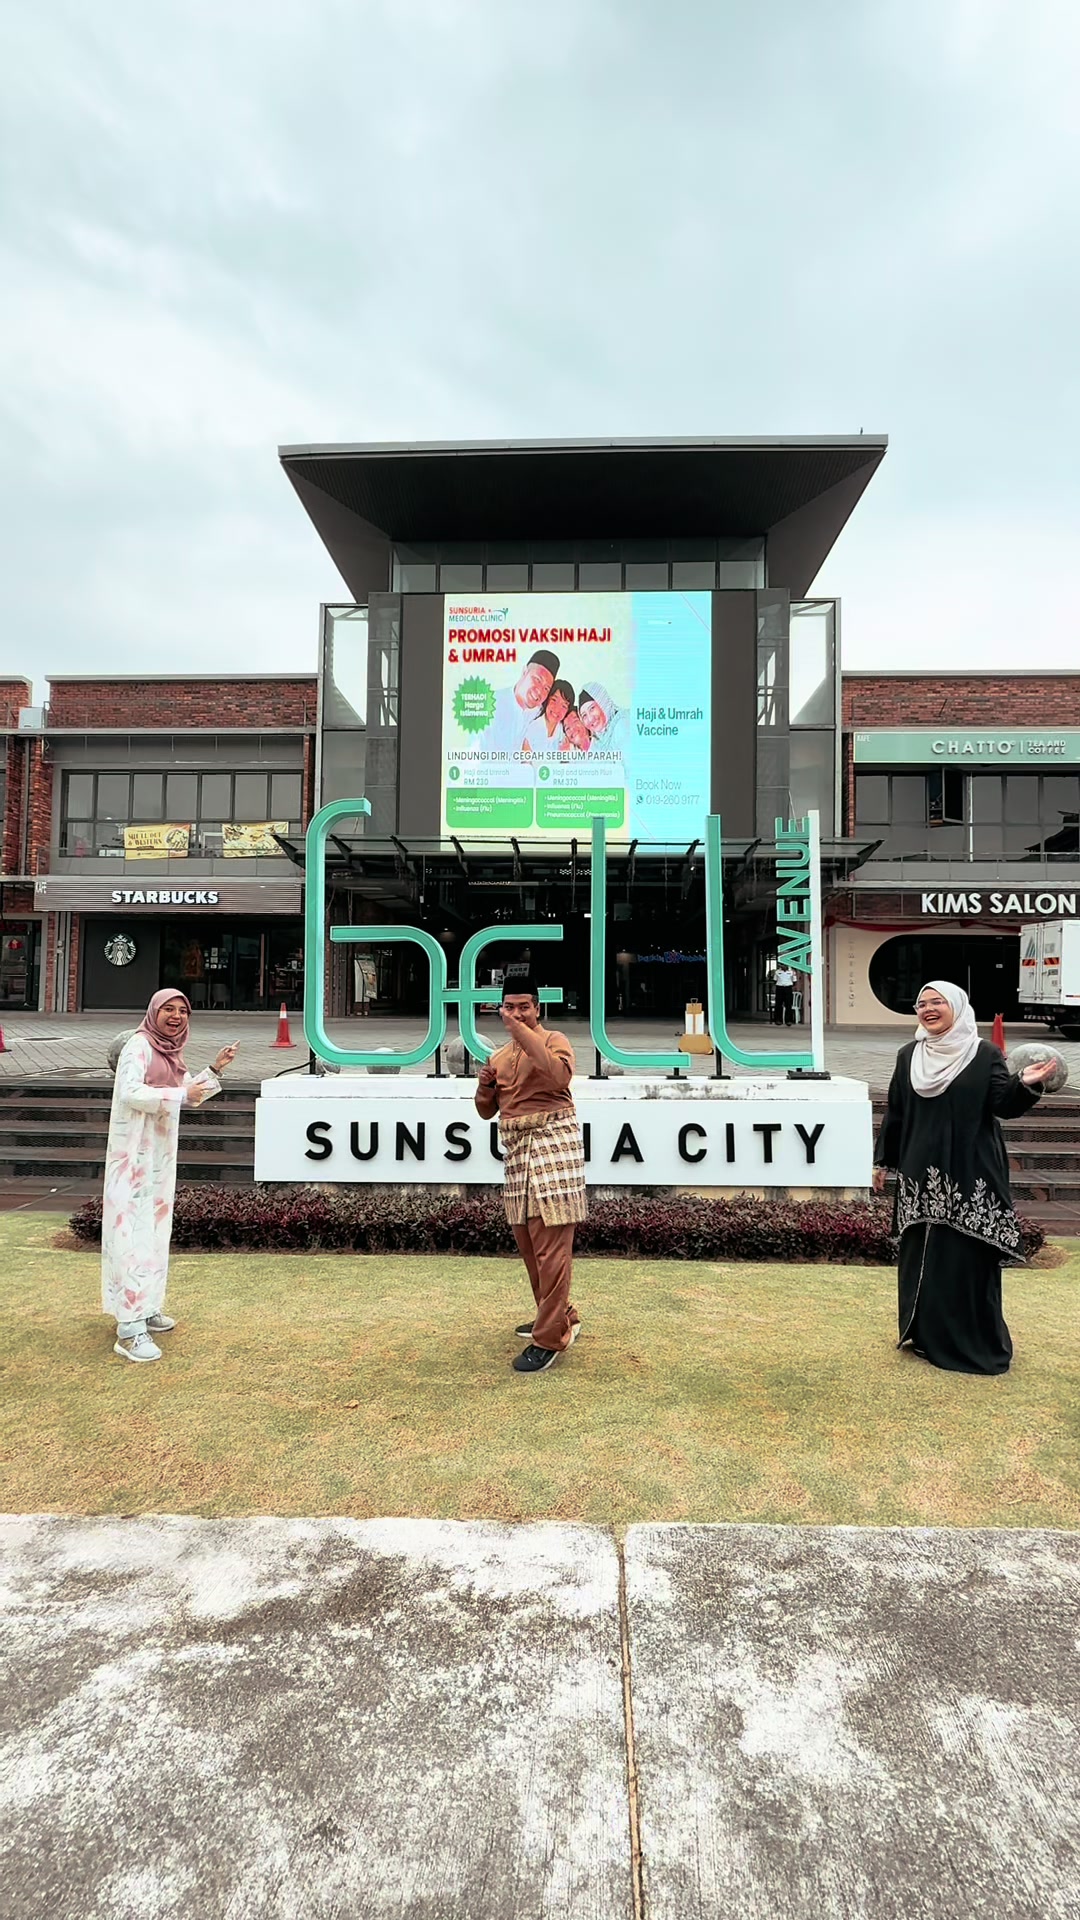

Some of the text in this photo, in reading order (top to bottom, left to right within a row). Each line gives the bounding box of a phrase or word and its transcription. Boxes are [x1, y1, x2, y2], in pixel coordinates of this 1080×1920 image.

[449, 628, 611, 643] PROMOSI VAKSIN HAJI
[448, 648, 517, 663] & UMRAH
[637, 708, 703, 722] Haji & Umrah
[637, 724, 679, 736] Vaccine
[447, 751, 622, 761] LINDUNGI DIRI, CEGAH SEBELUM PARAH!
[636, 779, 681, 790] Book Now
[646, 795, 680, 805] 019-260
[112, 890, 219, 904] STARBUCKS
[775, 816, 812, 975] AVENUE
[921, 893, 1076, 914] KIMS SALON
[304, 1121, 826, 1164] SUNSUIA CITY
